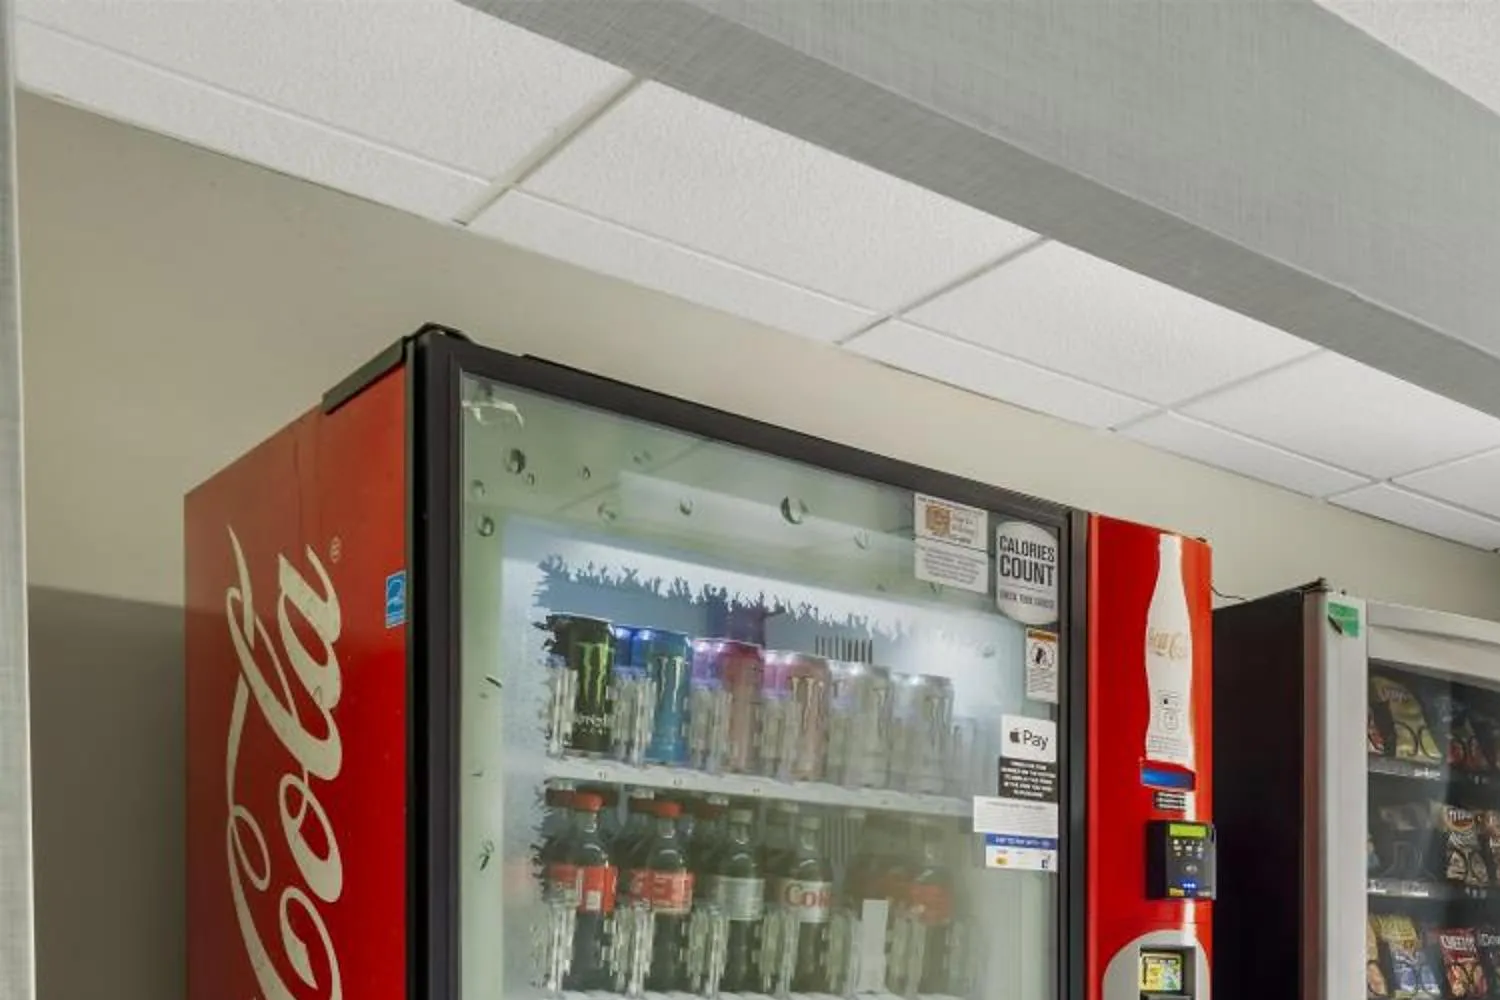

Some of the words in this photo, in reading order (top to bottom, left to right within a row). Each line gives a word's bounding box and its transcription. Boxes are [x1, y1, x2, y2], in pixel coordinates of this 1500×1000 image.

[998, 535, 1055, 563] CALORIES
[999, 555, 1055, 587] COUNT
[1023, 729, 1049, 750] Pay
